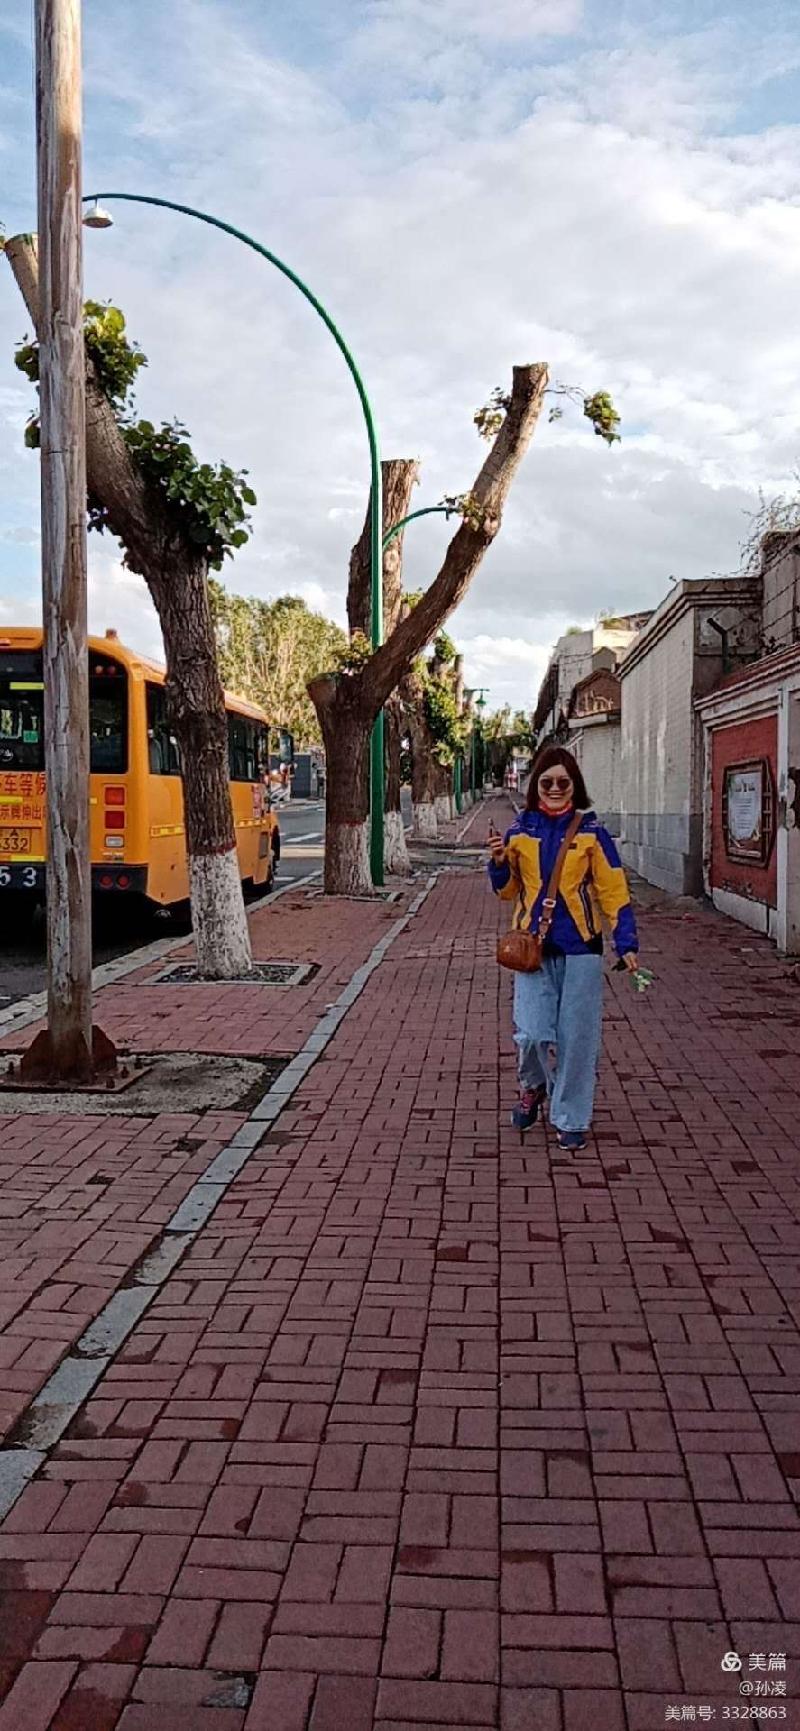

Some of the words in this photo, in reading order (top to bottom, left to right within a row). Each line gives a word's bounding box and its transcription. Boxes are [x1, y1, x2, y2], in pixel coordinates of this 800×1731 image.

[0, 773, 46, 794] 车等候
[0, 837, 28, 850] 332
